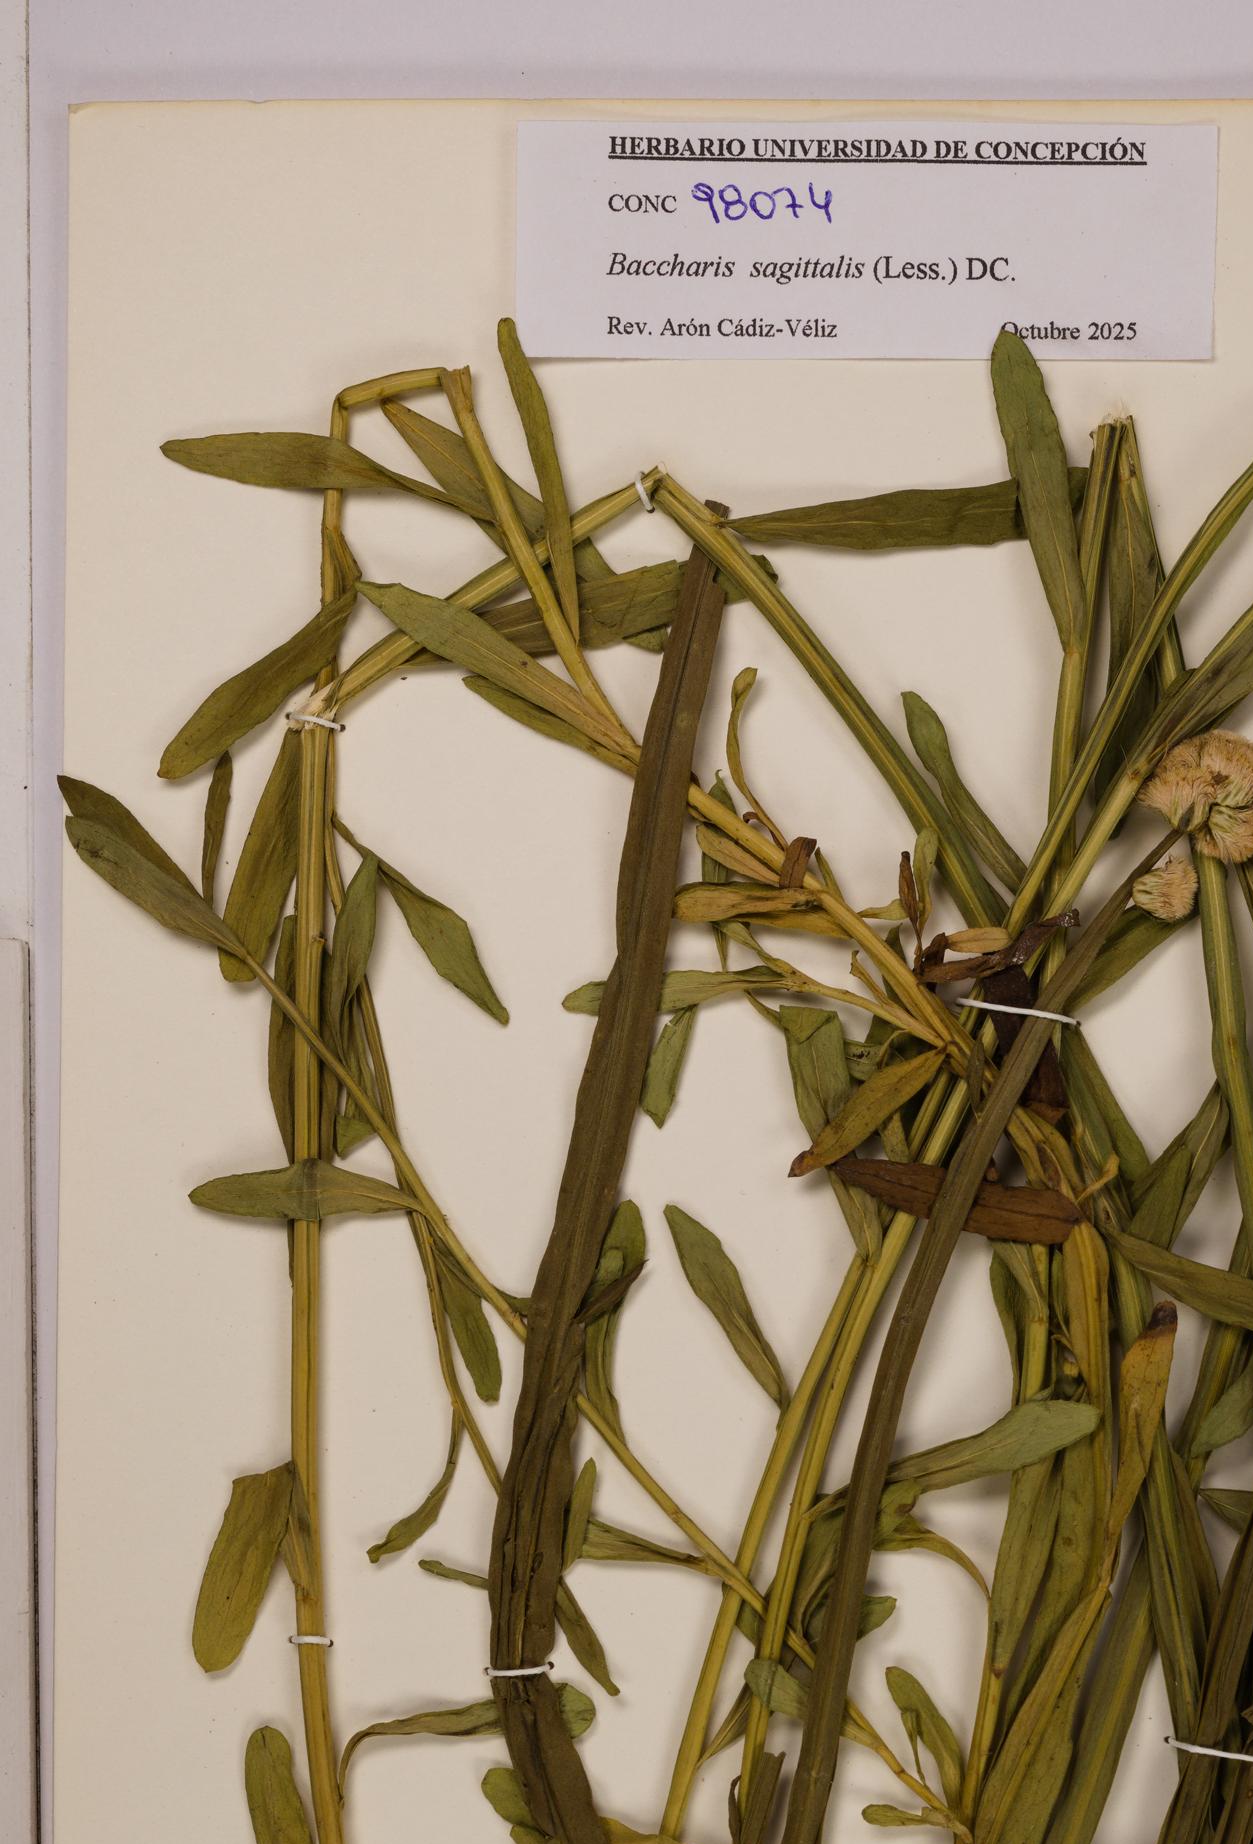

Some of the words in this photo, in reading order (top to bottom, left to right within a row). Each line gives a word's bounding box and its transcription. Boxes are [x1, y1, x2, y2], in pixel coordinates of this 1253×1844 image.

[609, 136, 745, 160] HERBARIO
[753, 137, 929, 161] UNIVERSIDAD
[934, 139, 969, 160] DE
[974, 137, 1146, 162] CONCEPCIÓN
[608, 194, 676, 213] CONC
[692, 183, 832, 223] 98074
[606, 253, 735, 277] Baccharis
[750, 256, 865, 285] sagittalis
[873, 256, 957, 285] (Less.)
[966, 257, 1015, 281] DC.
[608, 316, 652, 335] Rev.
[660, 318, 711, 336] Arón
[718, 318, 837, 337] Cádiz-Véliz
[1001, 321, 1081, 340] Octubre
[1088, 322, 1136, 340] 2025
